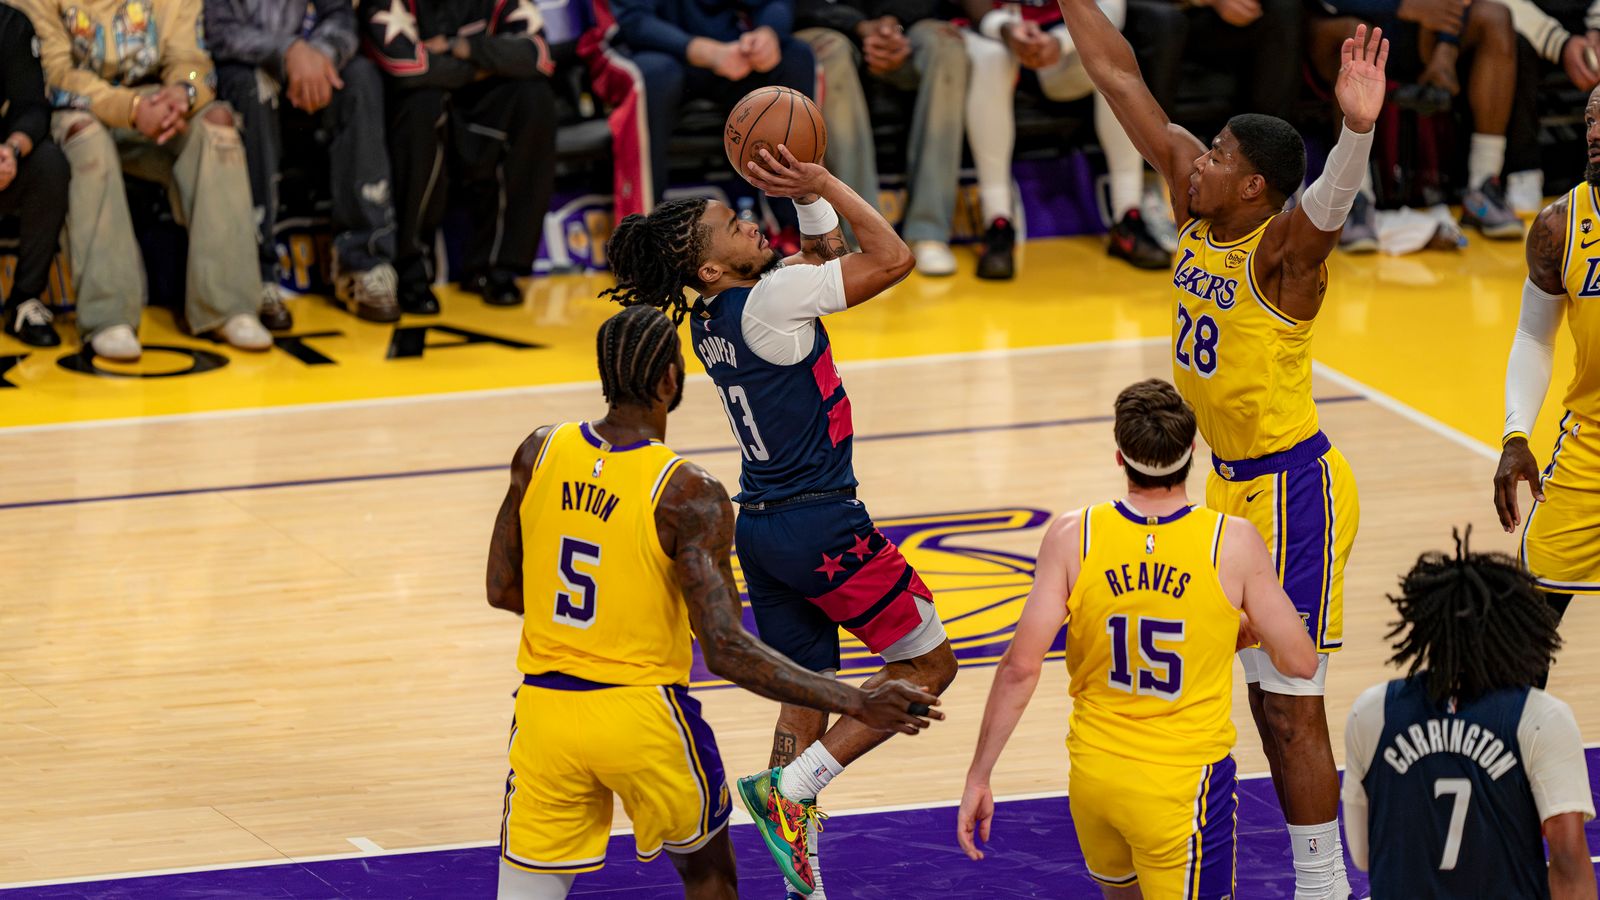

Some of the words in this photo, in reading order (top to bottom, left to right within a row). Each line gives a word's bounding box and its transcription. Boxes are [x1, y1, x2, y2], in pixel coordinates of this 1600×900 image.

[1173, 248, 1239, 311] LAKRS
[0, 324, 548, 388] OTA
[698, 336, 738, 369] COOPER
[1176, 301, 1219, 379] 28
[561, 481, 620, 522] AYTON
[552, 534, 602, 630] 5
[1104, 561, 1192, 599] REAVES
[1106, 613, 1185, 701] 15
[1383, 718, 1517, 781] CARRINGTON
[1434, 777, 1472, 870] 7
